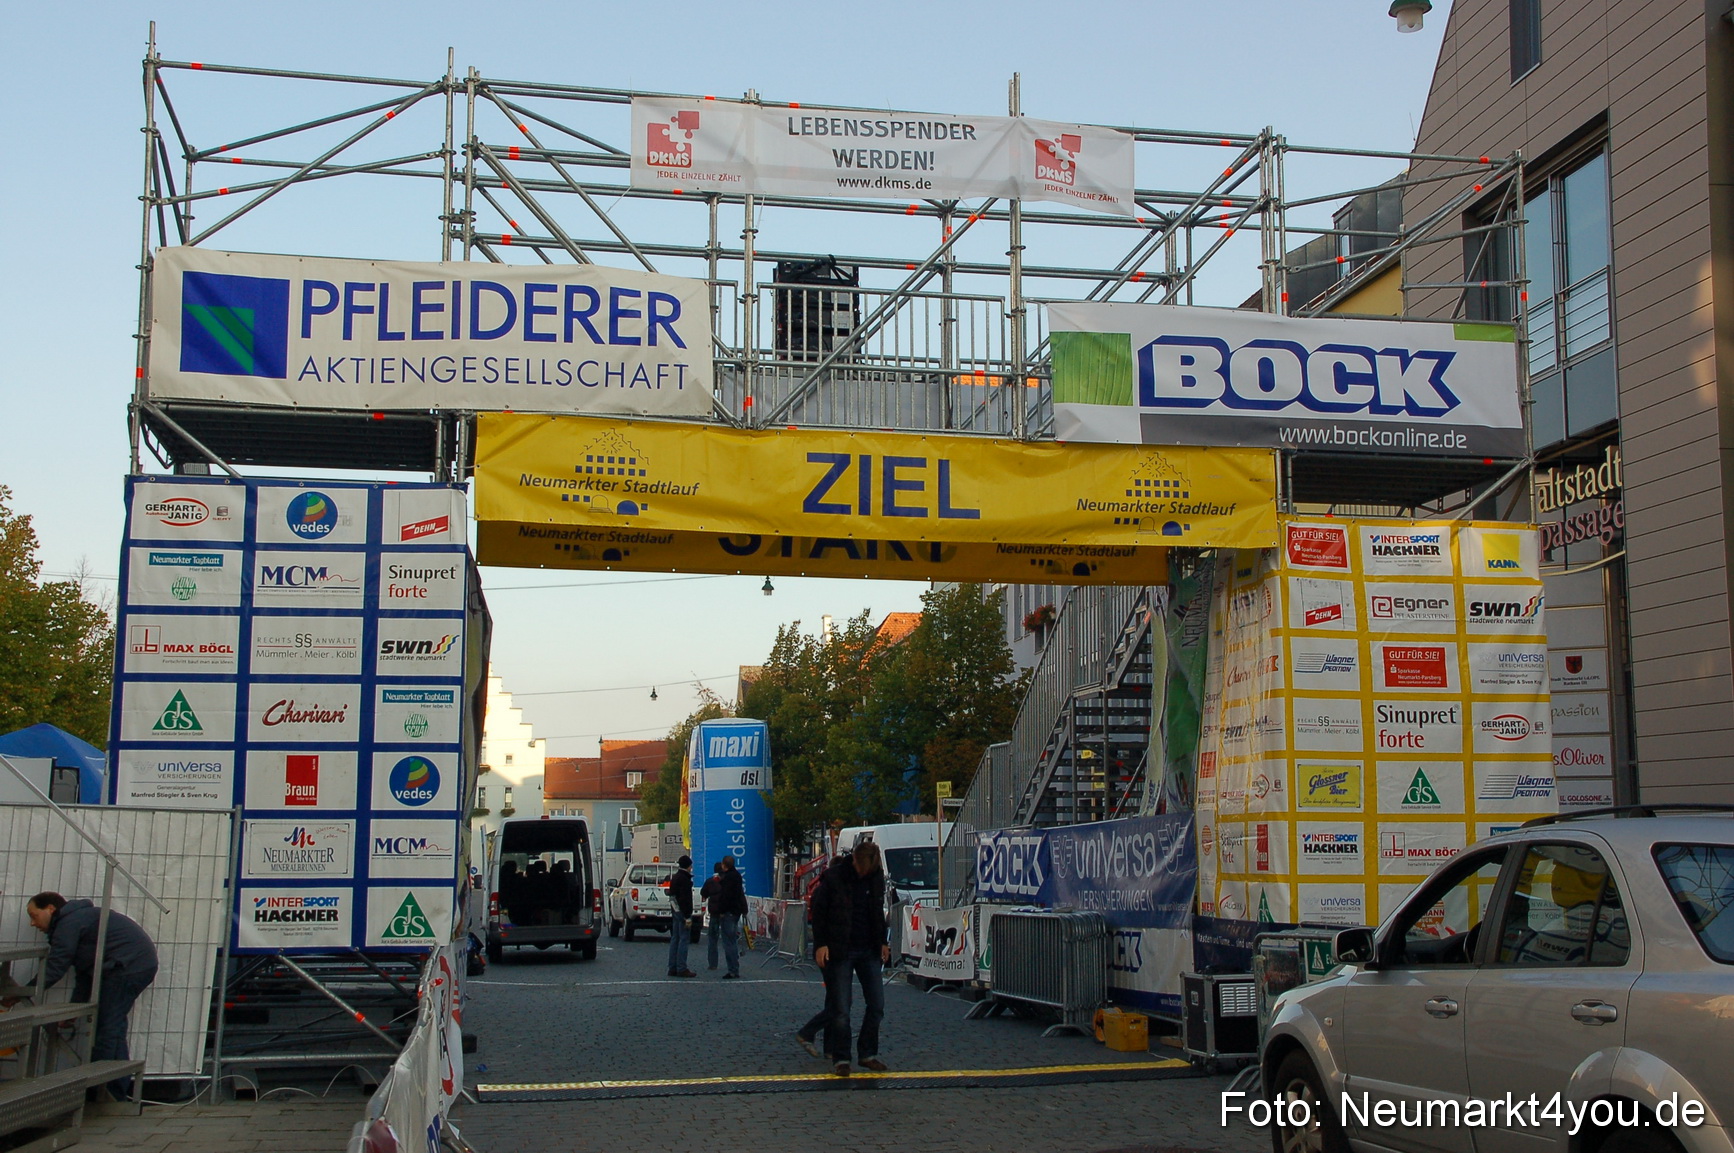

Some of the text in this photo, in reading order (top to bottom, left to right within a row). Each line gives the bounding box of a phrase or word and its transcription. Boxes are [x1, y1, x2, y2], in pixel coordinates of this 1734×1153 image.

[788, 117, 977, 141] LEBENSSPENDER
[649, 151, 690, 166] DKMS
[832, 148, 935, 171] WERDEN!
[657, 170, 741, 182] JEDER EINZELNE ZÄHLT
[1037, 165, 1072, 184] DKMS
[836, 176, 932, 190] www.dkms.de
[1044, 183, 1064, 194] JEDER
[1066, 188, 1096, 200] EINZELNE
[300, 279, 688, 350] PFLEIDERER
[297, 354, 690, 391] AKTIENGESELLSCHAFT
[1138, 334, 1462, 418] BOCK
[1278, 424, 1468, 450] www.bockonline.de
[519, 473, 700, 496] Neumarkter Stadtlauf
[803, 451, 981, 520] ZIEL
[1537, 445, 1623, 513] altstadt
[145, 503, 197, 512] GERHART
[1076, 498, 1237, 517] Neumarkter Stadtlauf
[168, 511, 203, 520] JANIG
[292, 521, 331, 534] vedes
[413, 522, 436, 535] DEHN
[518, 525, 675, 545] Neumarkter Stadtlauf
[1539, 500, 1624, 562] passage
[1291, 530, 1340, 541] GUT FÜR SIE!
[1381, 534, 1440, 543] INTERSPORT
[996, 543, 1137, 558] Neumarkter Stadtlauf
[1372, 545, 1441, 556] HACKNER
[152, 555, 221, 566] Neumarkter Tagblatt
[260, 565, 328, 586] MCM
[388, 564, 456, 582] Sinupret
[388, 583, 428, 599] forte
[1393, 597, 1449, 612] Egner
[1469, 601, 1522, 616] swn
[1505, 617, 1534, 625] neumarkt
[163, 642, 234, 654] MAX BÖGL
[257, 636, 292, 644] RECHTS
[315, 636, 357, 645] ANWÄLTE
[381, 640, 433, 655] swn
[256, 649, 357, 659] Mümmler Meier Kölbl
[1325, 653, 1355, 665] Wagner
[1389, 649, 1440, 660] GUT FÜR SIE!
[1397, 674, 1442, 682] Neumarkt-Parsberg
[385, 692, 451, 702] Neumarkter Tagblatt
[261, 698, 348, 727] Charivari
[1377, 704, 1457, 729] Sinupret
[1551, 704, 1600, 725] passion
[1324, 727, 1341, 735] Meier
[1481, 720, 1521, 728] GERHART
[1499, 727, 1526, 735] JANIG
[708, 731, 760, 759] maxi
[1378, 729, 1425, 748] forte
[1553, 747, 1606, 767] s.Oliver
[740, 770, 760, 786] dsl
[1308, 771, 1349, 796] Glossner
[156, 791, 180, 799] Stiegler
[284, 782, 315, 796] Braun
[395, 787, 433, 799] vedes
[1328, 784, 1348, 796] Bier
[1311, 833, 1358, 842] INTERSPORT
[374, 837, 427, 854] MCM
[1303, 843, 1358, 854] HACKNER
[1407, 848, 1431, 857] MAX
[263, 847, 334, 863] NEUMARKTER
[1073, 830, 1157, 884] uniVersa
[270, 863, 326, 872] MINERALBRUNNEN
[977, 835, 1045, 895] BOCK
[267, 896, 340, 908] INTERSPORT
[1078, 889, 1155, 912] VERSICHERUNGEN
[254, 909, 339, 923] HACKNER
